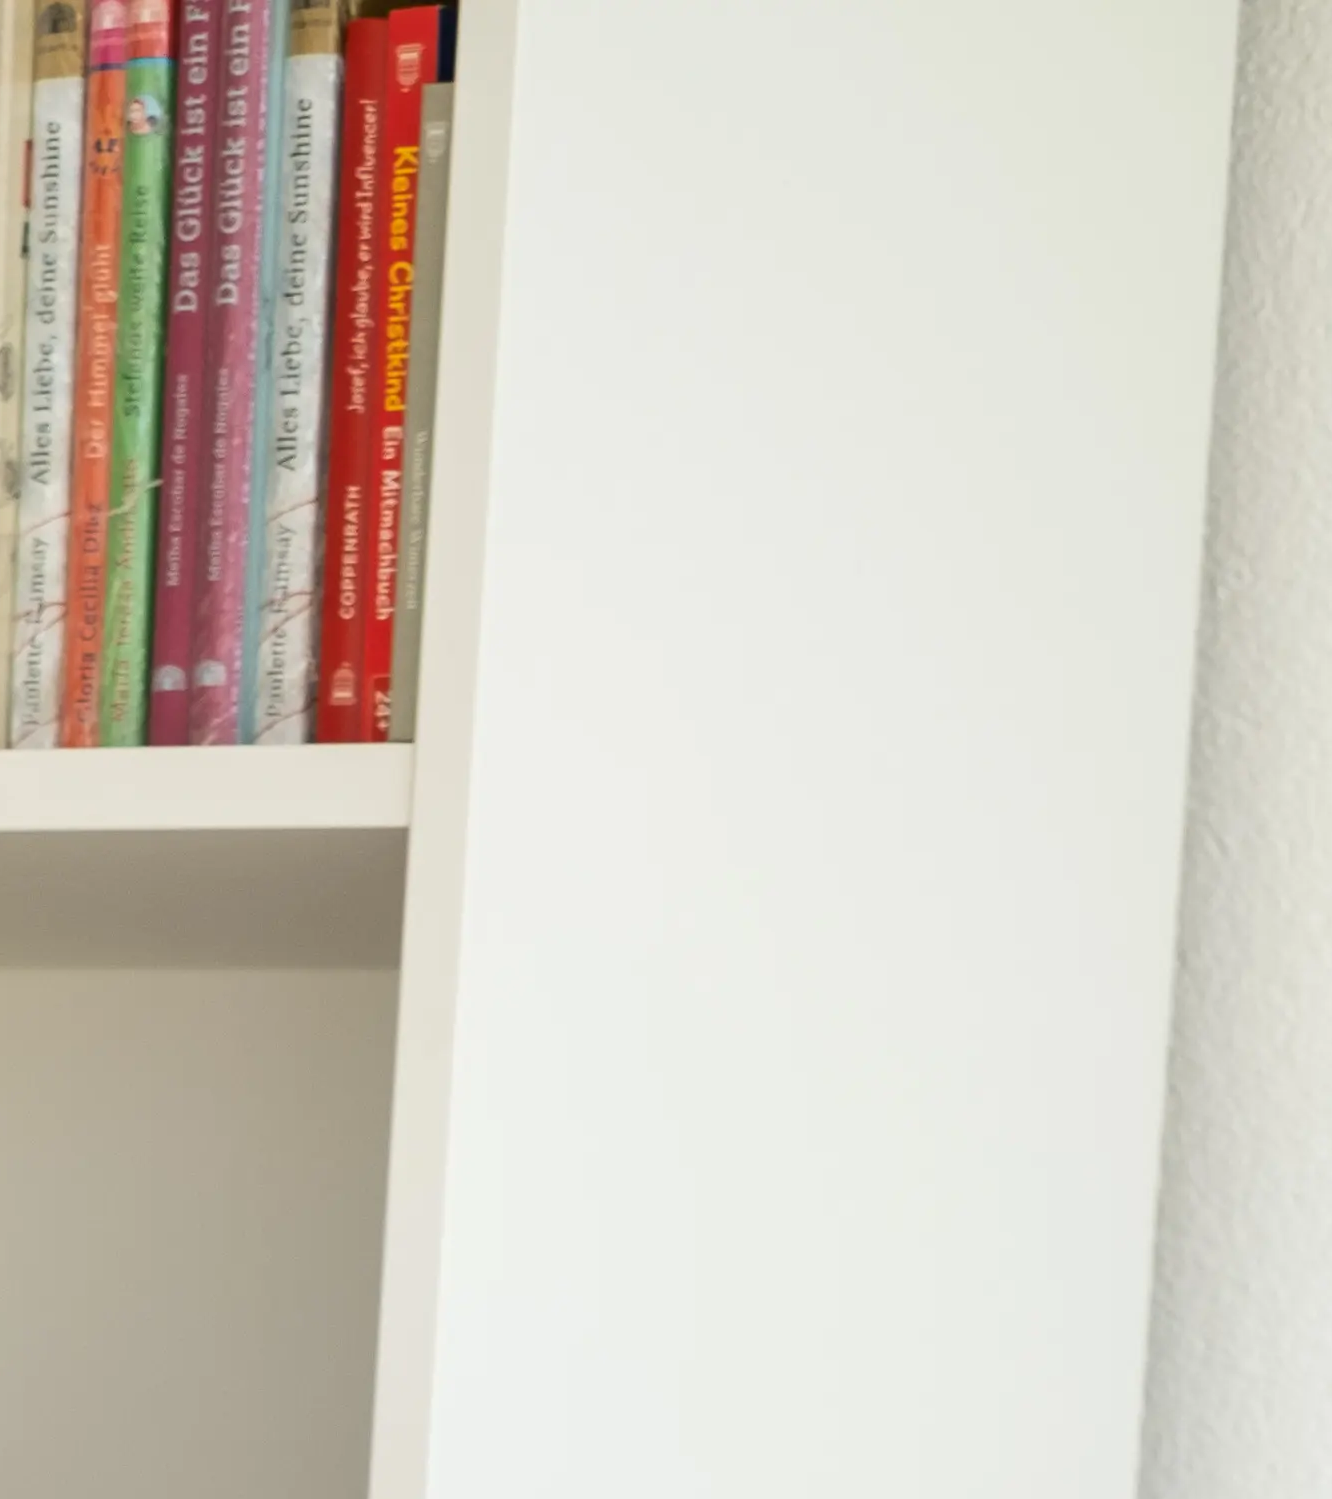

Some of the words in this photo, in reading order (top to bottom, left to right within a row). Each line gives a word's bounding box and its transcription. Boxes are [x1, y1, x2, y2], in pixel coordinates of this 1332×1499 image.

[182, 32, 211, 86] ein
[228, 22, 255, 76] ein
[180, 94, 207, 136] ist
[224, 85, 251, 128] ist
[173, 144, 208, 241] Glück
[220, 137, 250, 235] Glück
[390, 144, 421, 249] Kleines
[171, 251, 199, 313] Das
[219, 244, 245, 306] Das
[381, 260, 415, 413] Christkind
[383, 426, 403, 460] Ein
[336, 484, 364, 620] COPPENRATH
[373, 468, 400, 622] Mitmachbuch
